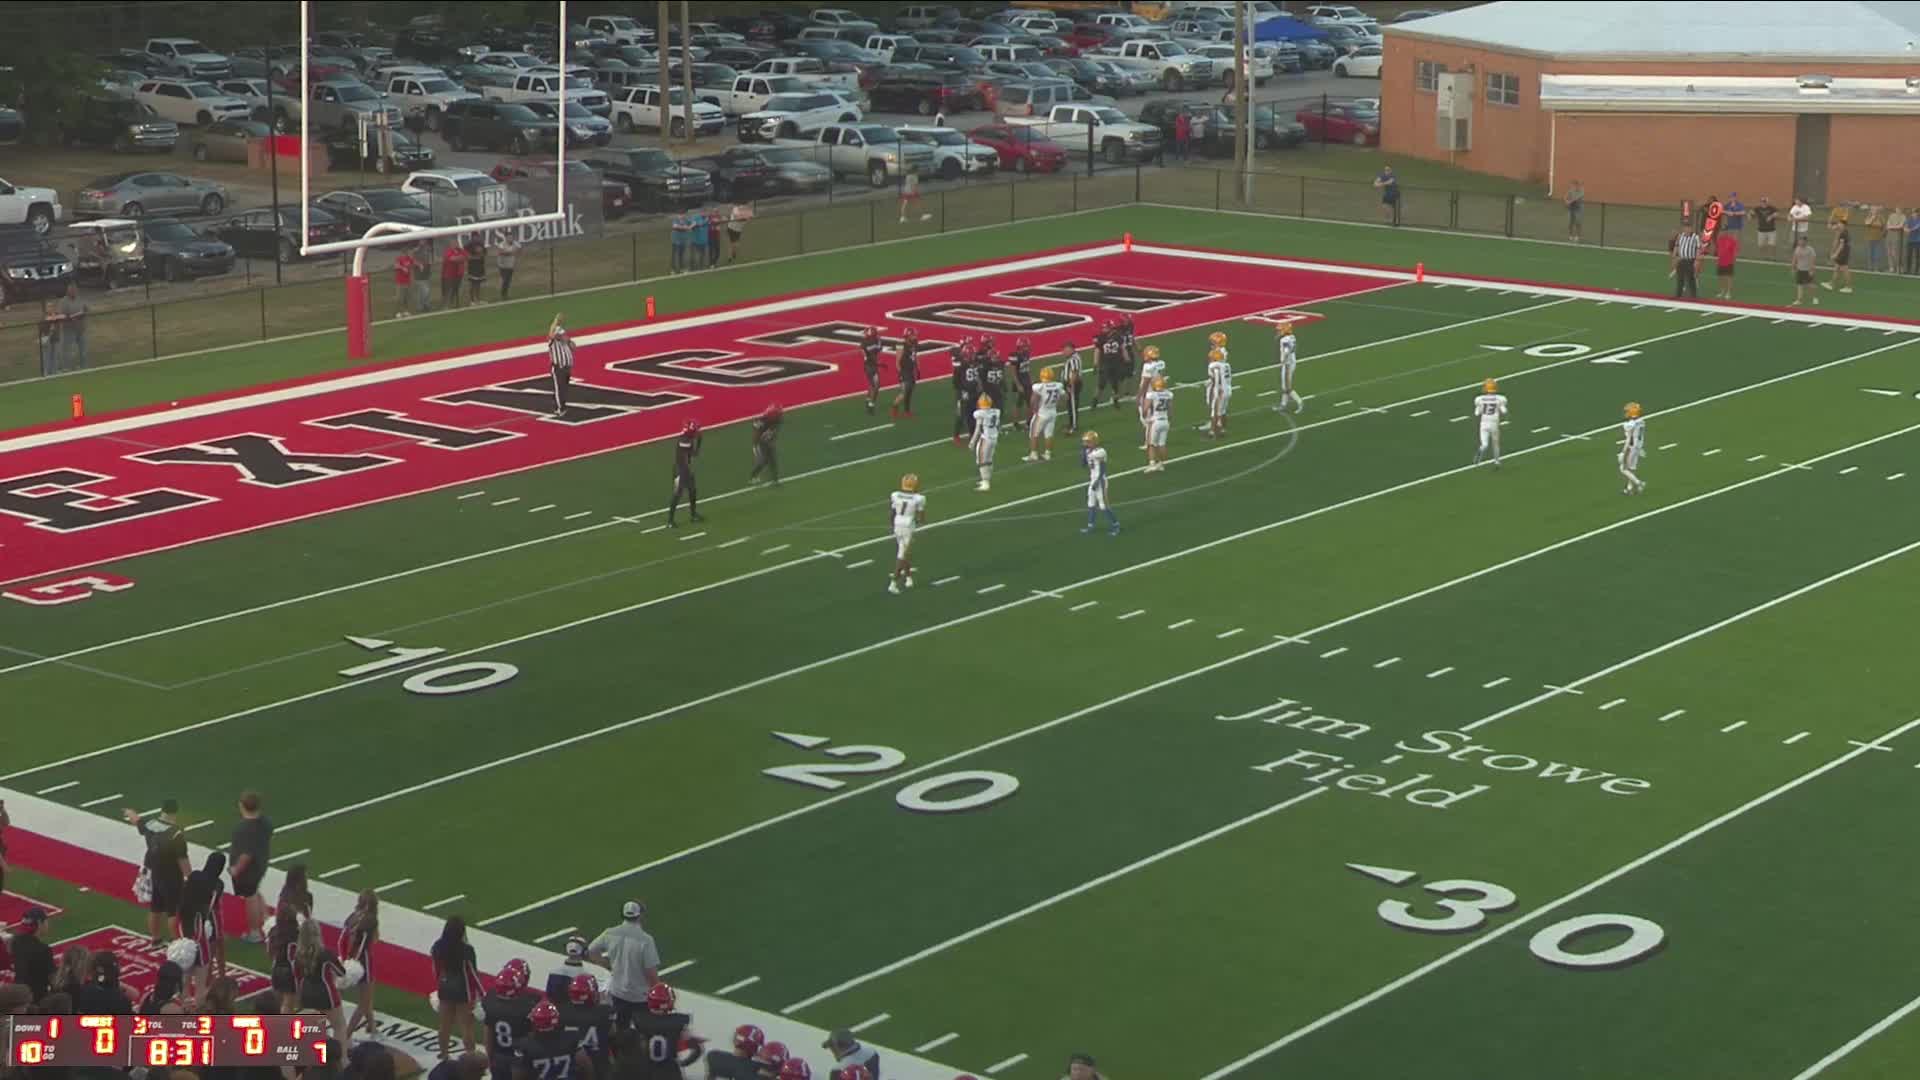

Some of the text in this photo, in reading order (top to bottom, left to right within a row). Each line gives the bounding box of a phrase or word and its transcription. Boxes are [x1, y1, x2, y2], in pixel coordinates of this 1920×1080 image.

[517, 203, 584, 243] Bank
[1216, 697, 1651, 795] Jim Stowe
[762, 744, 1020, 811] 20
[1250, 748, 1490, 809] Field
[1377, 879, 1664, 967] 30
[495, 1020, 513, 1048] 8
[648, 1035, 667, 1062] 0
